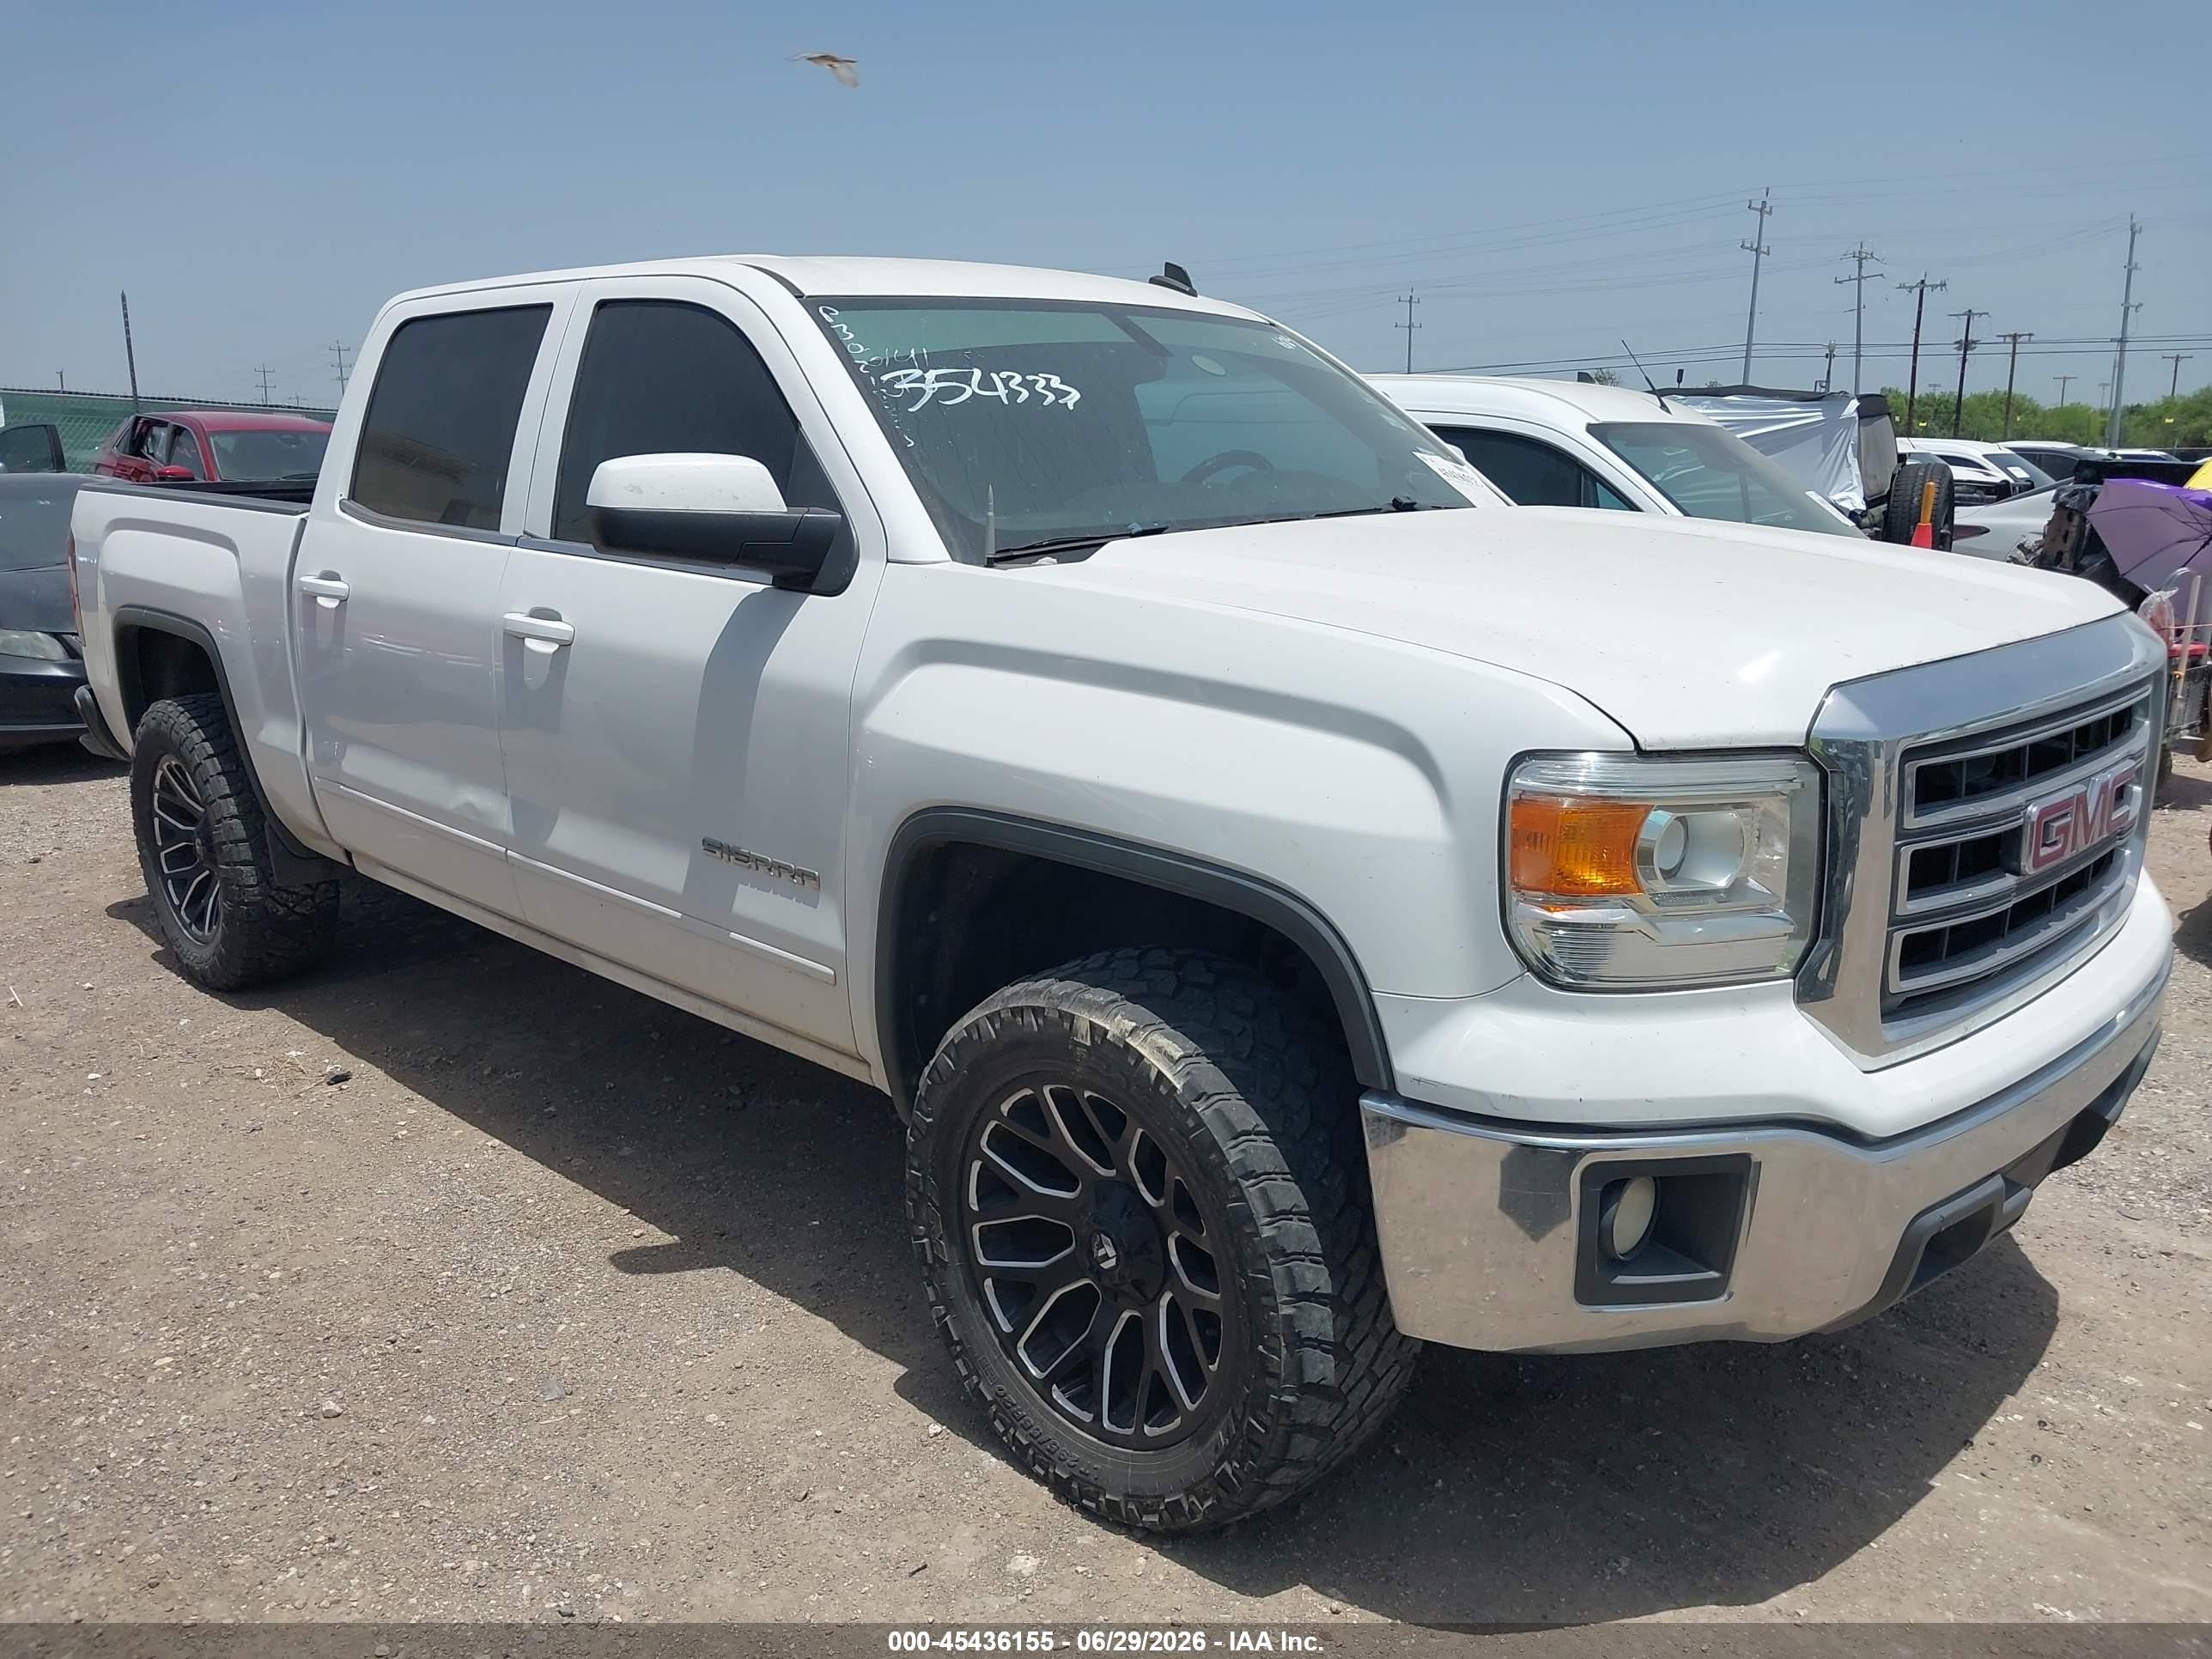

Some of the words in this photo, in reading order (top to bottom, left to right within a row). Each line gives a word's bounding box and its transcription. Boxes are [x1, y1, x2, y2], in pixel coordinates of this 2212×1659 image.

[880, 368, 1081, 412] 354333
[2021, 758, 2137, 875] GMC
[701, 836, 821, 891] SIERRA
